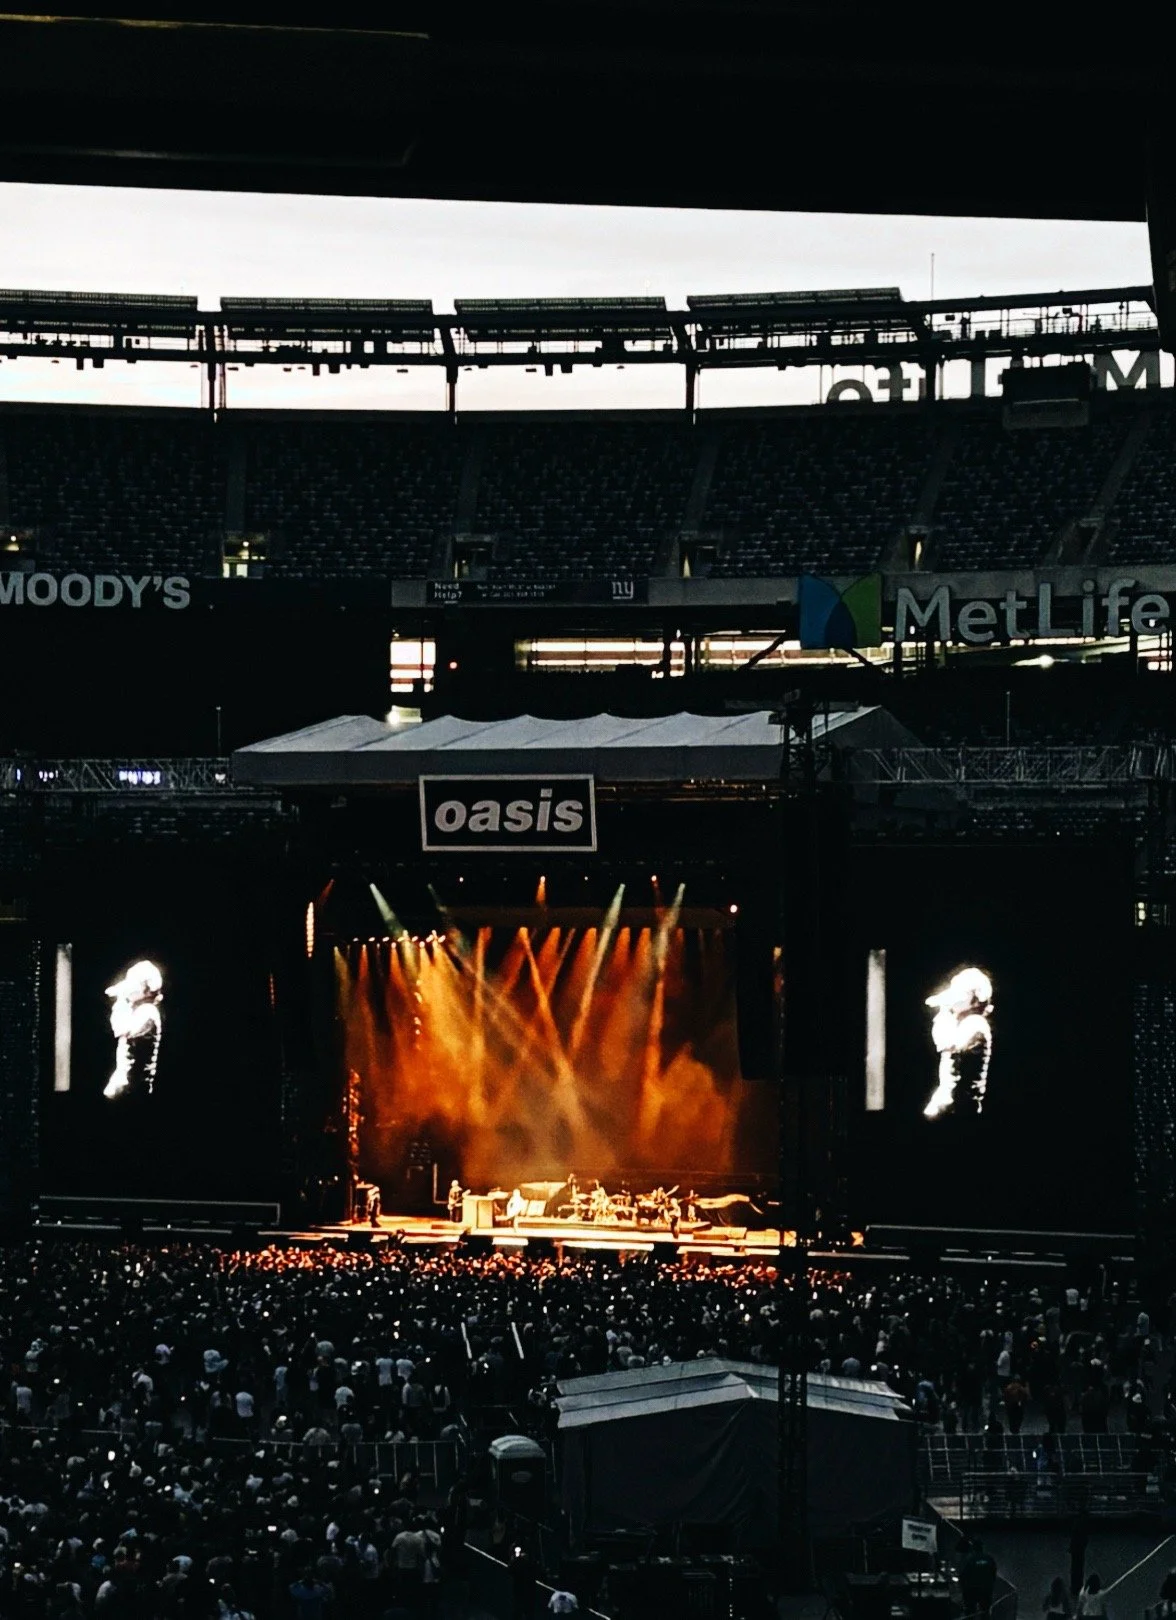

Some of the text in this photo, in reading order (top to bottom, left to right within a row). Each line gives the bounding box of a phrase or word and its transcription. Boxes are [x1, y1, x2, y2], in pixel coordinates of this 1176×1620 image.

[0, 571, 191, 610] MOODY'S
[611, 581, 634, 600] ny
[896, 578, 1170, 643] MetLife
[434, 788, 584, 833] oasis
